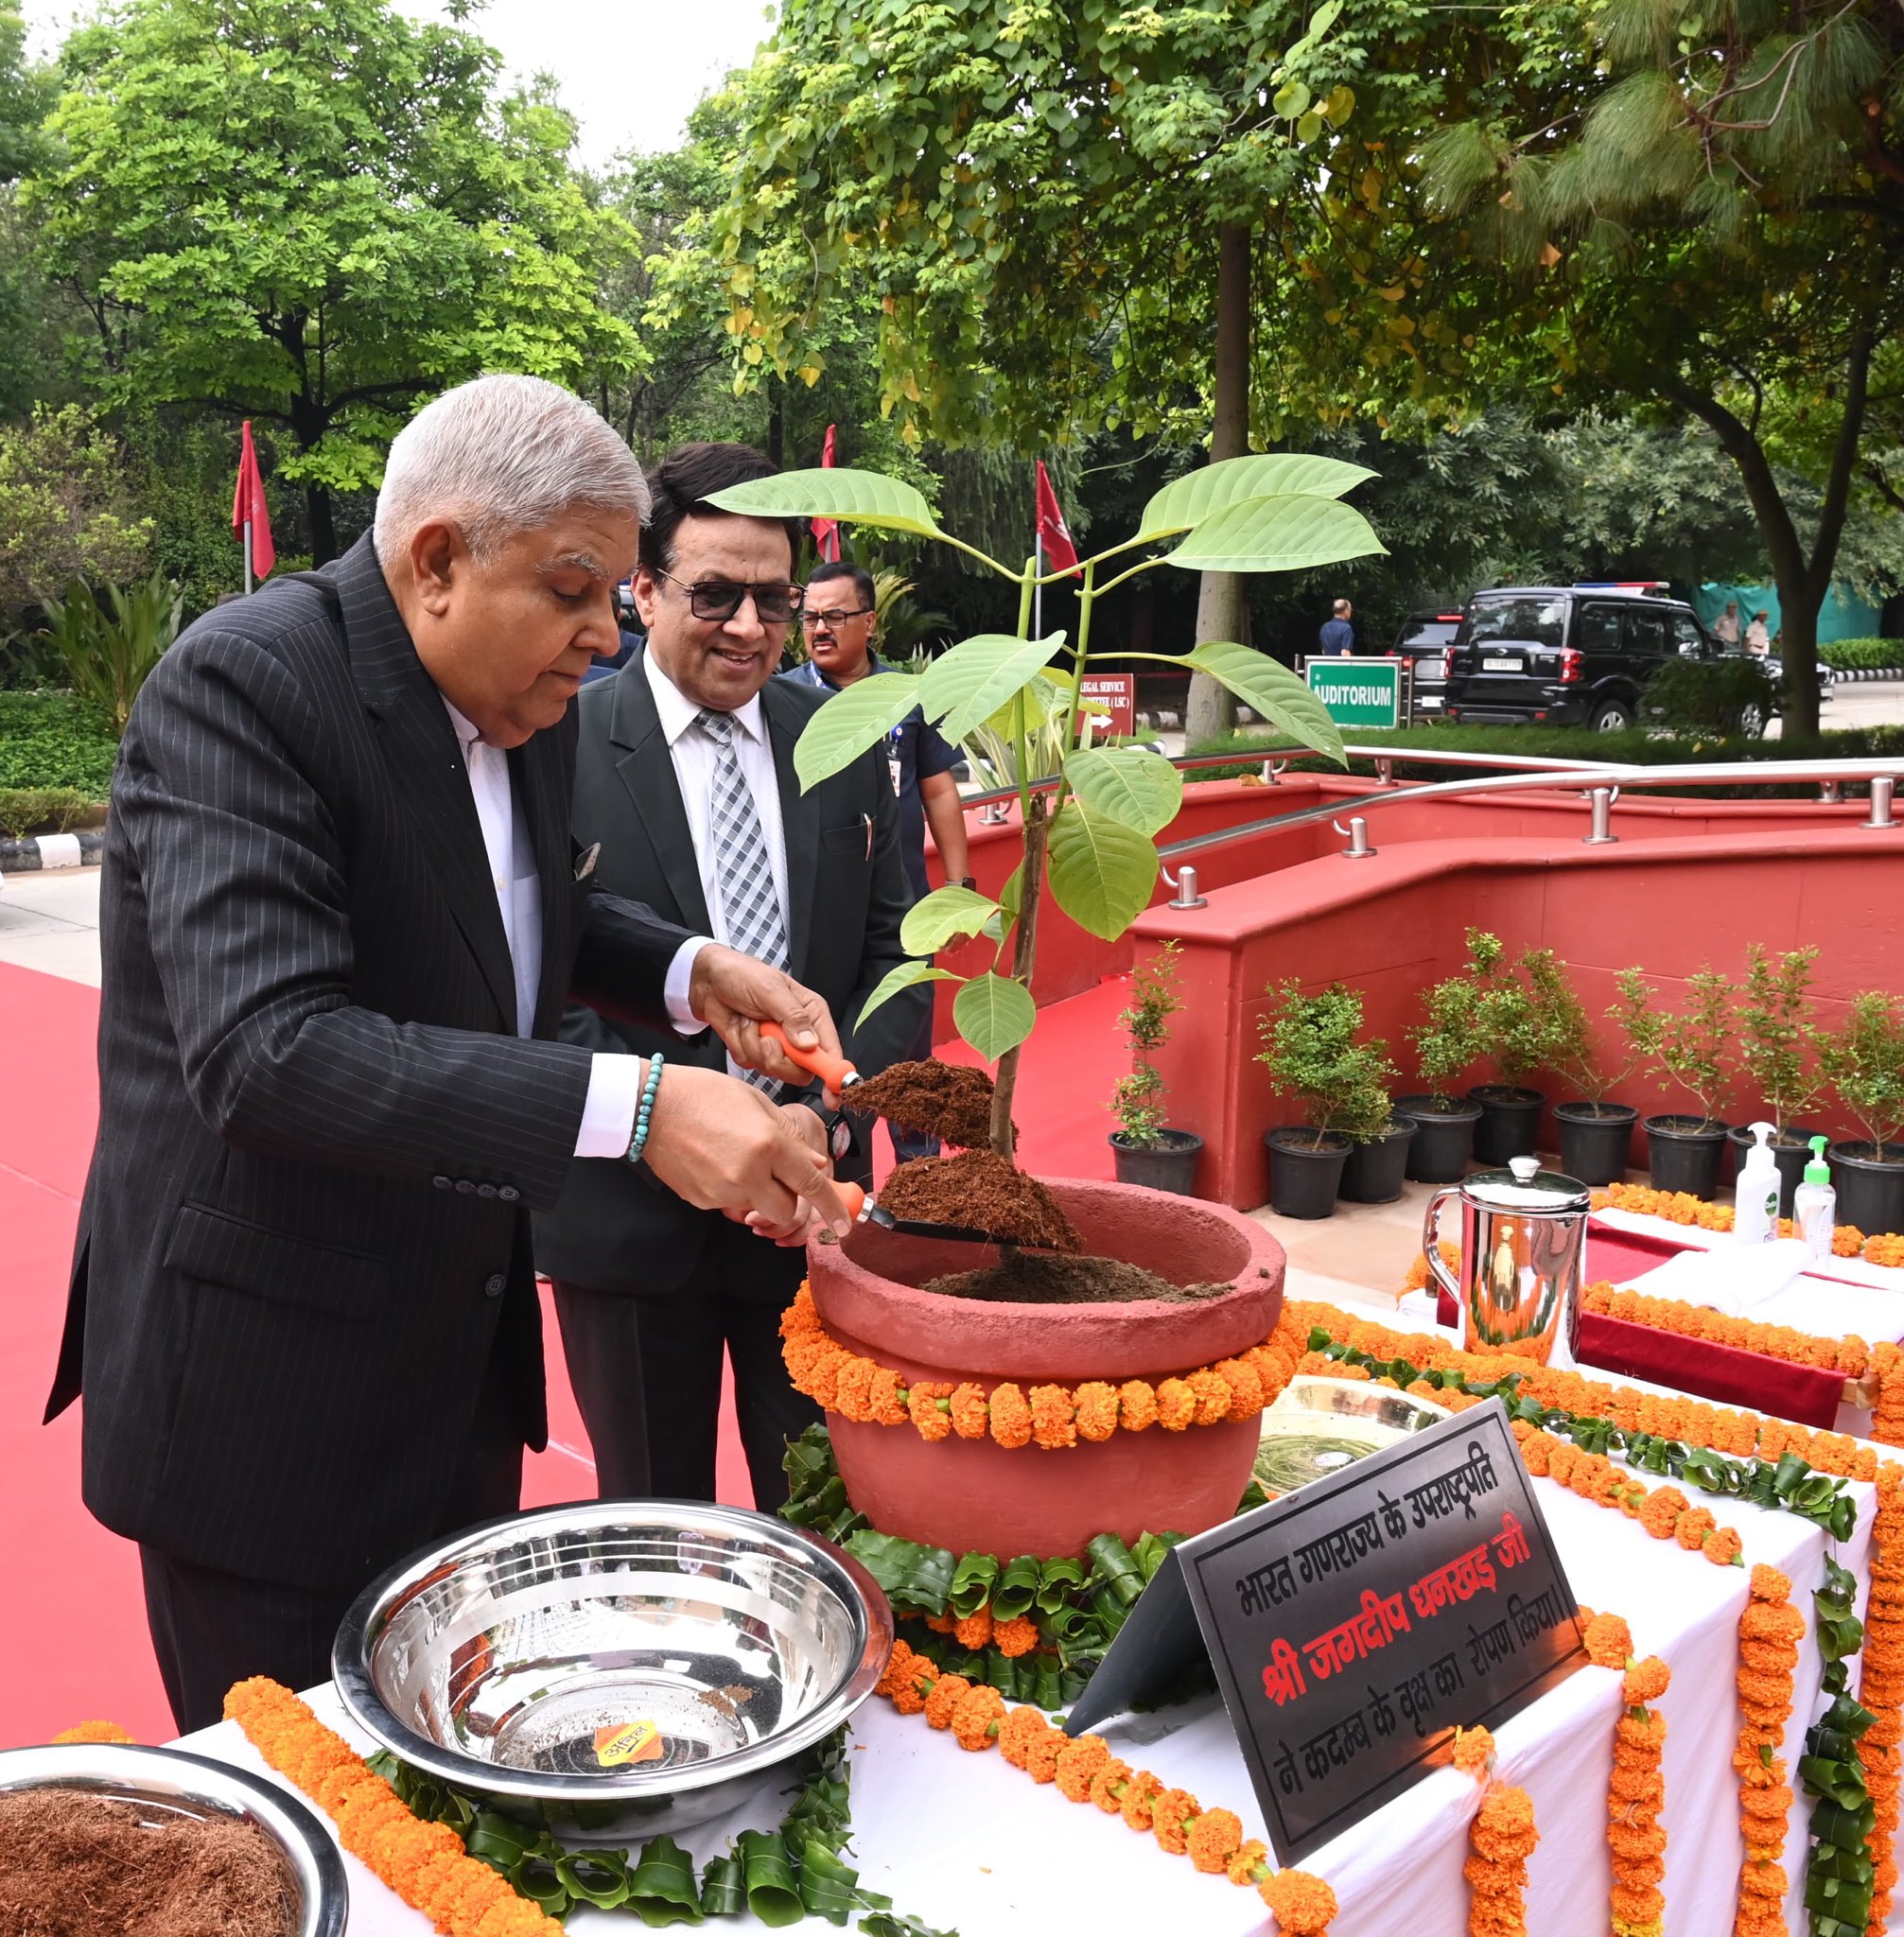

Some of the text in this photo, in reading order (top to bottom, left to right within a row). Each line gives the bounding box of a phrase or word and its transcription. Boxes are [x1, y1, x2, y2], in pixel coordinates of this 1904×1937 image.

[1080, 681, 1126, 692] LEGAL SERVICE
[1314, 684, 1391, 707] AUDITORIUM
[1235, 1440, 1499, 1617] भारत गणराज्य के उपराष्ट्रपति
[1262, 1637, 1307, 1707] श्री
[1301, 1589, 1411, 1680] जगदीप
[1491, 1511, 1531, 1569] जी
[1273, 1738, 1304, 1795] ने
[1299, 1709, 1371, 1781] कदम्ब
[1367, 1684, 1396, 1736] के
[1393, 1669, 1435, 1738] वृक्ष
[1429, 1651, 1465, 1698] का
[1464, 1623, 1516, 1676] रोपण
